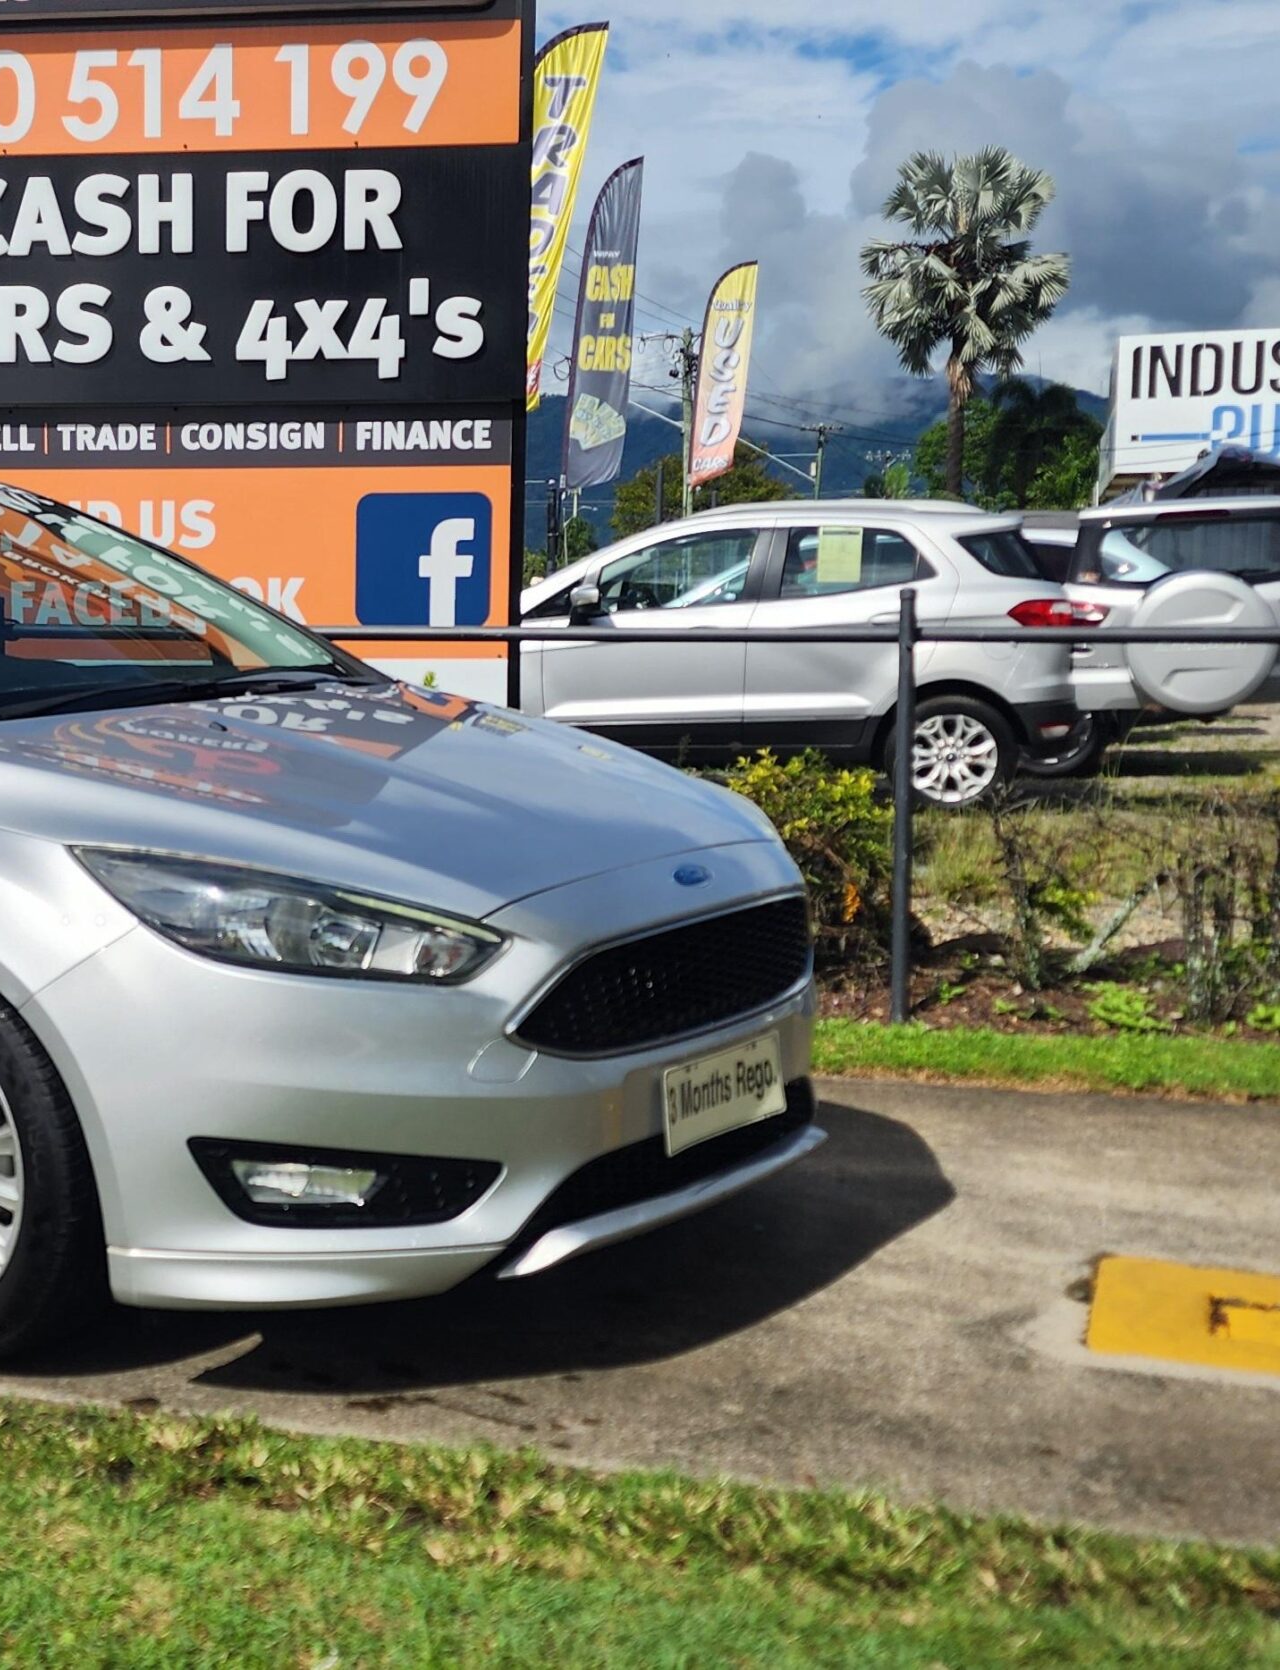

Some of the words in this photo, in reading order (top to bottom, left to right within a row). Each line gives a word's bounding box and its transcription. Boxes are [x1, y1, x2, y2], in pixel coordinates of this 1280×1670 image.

[61, 45, 240, 142] 514
[274, 39, 448, 135] 199
[226, 169, 402, 252] FOR
[139, 285, 211, 363] &
[699, 317, 745, 447] USED
[56, 424, 157, 452] TRADE
[180, 421, 325, 452] CONSIGN
[356, 419, 492, 451] FINANCE
[140, 499, 216, 549] US
[681, 1068, 732, 1120] Months
